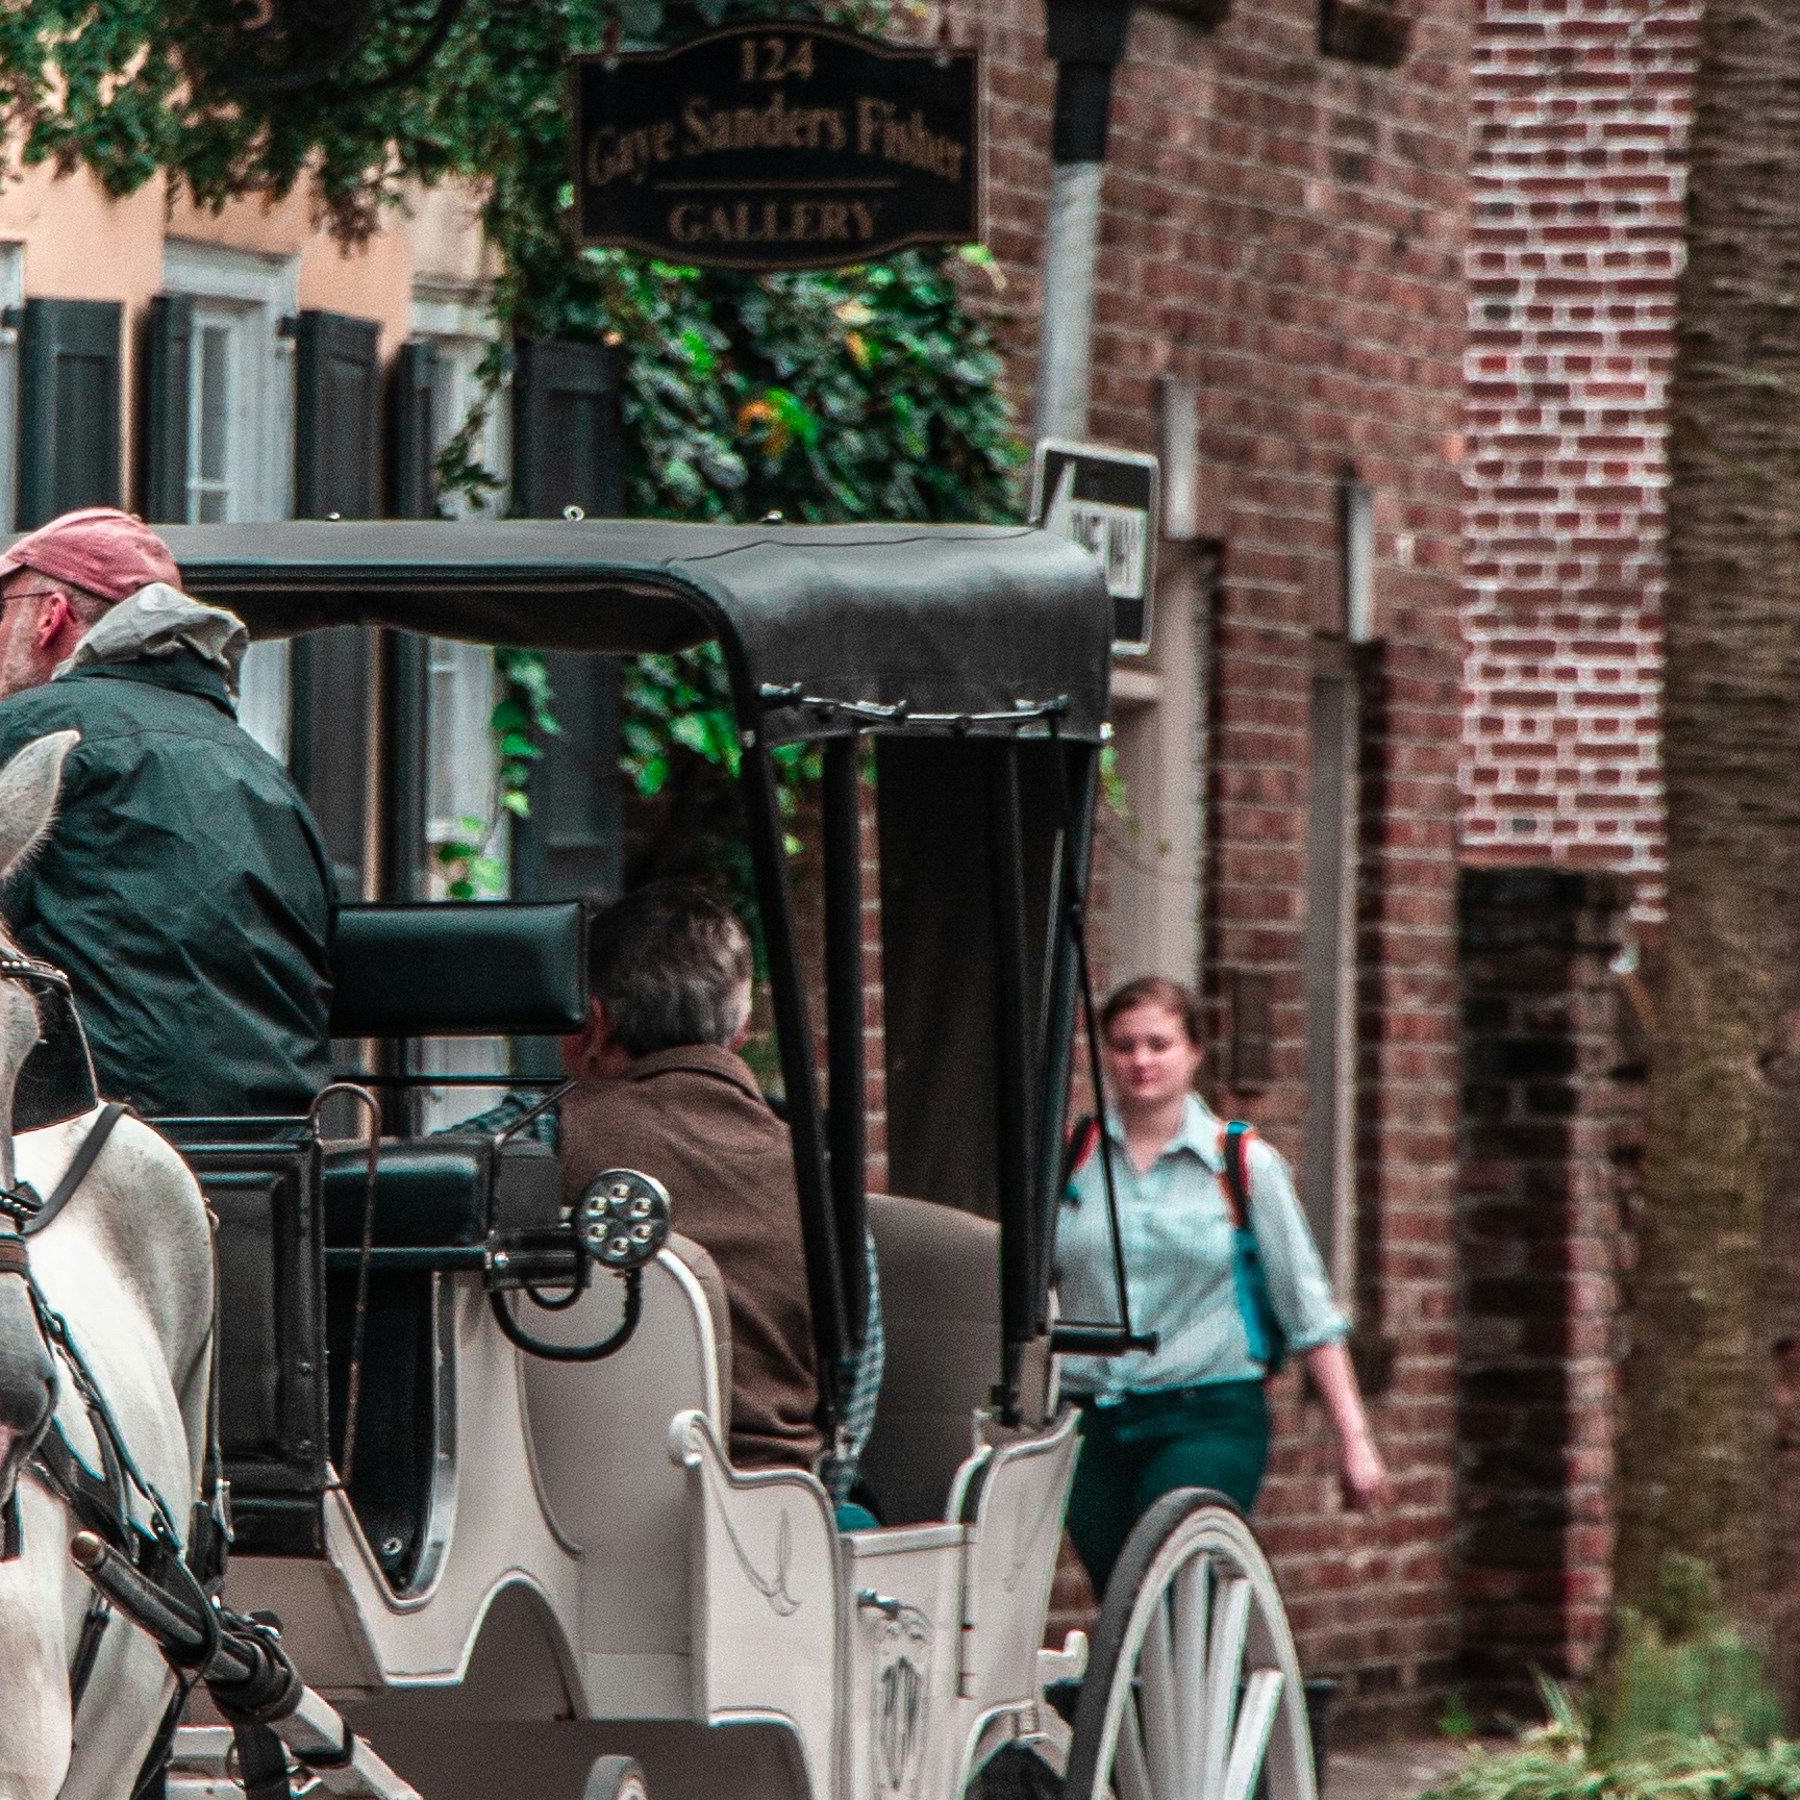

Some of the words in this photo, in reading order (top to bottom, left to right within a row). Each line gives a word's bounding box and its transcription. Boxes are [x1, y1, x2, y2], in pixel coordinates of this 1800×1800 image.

[739, 38, 816, 81] 124
[682, 92, 848, 155] Sanders
[667, 200, 882, 242] GALLERY
